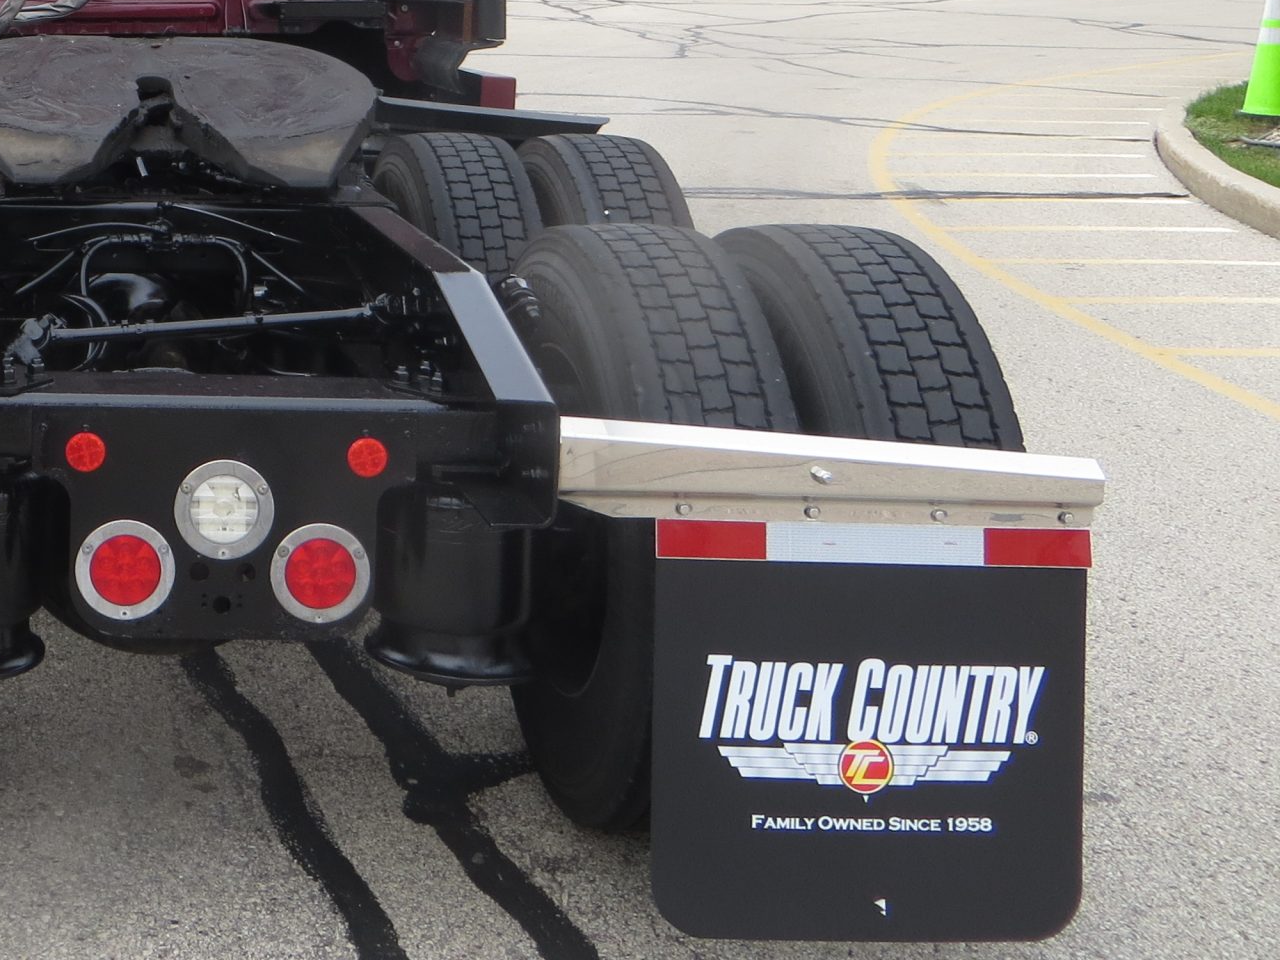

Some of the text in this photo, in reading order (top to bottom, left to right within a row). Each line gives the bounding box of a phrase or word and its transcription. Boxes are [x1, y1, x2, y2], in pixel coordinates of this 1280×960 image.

[699, 654, 844, 741] TRUCK
[751, 814, 992, 832] FAMILY OWNED SINCE 1958
